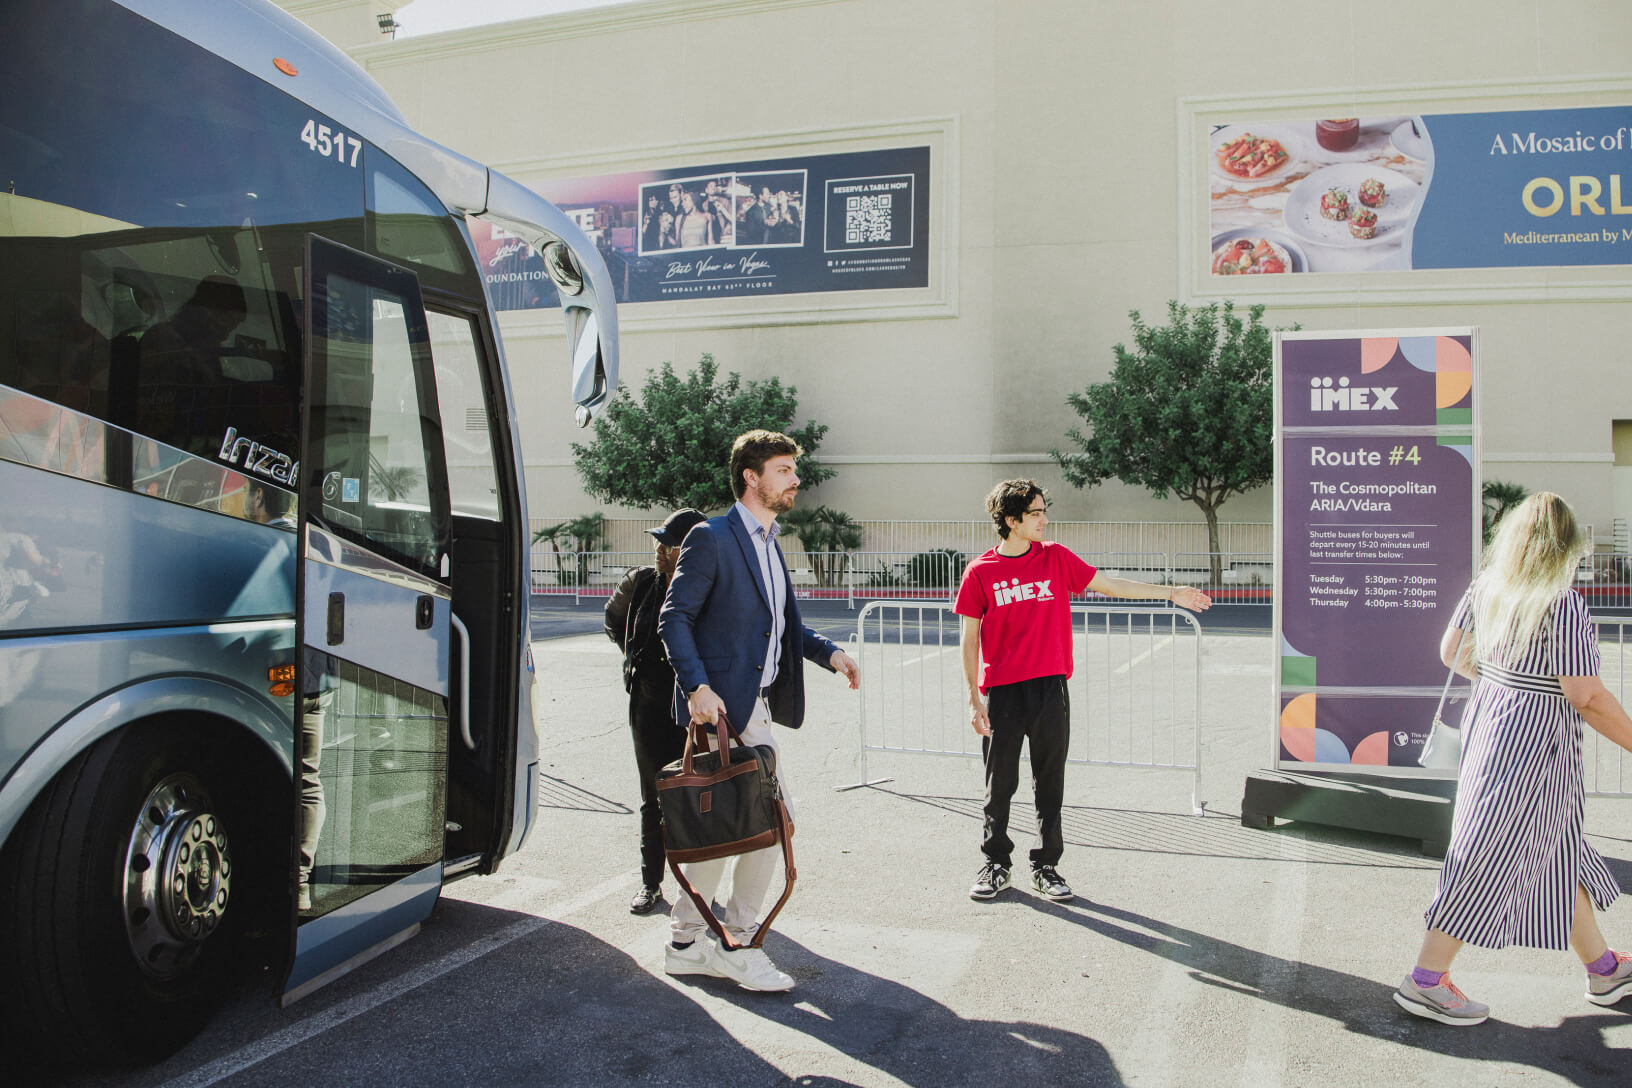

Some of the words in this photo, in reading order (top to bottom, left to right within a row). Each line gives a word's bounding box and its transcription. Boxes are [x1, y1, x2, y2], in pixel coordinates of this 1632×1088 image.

[301, 119, 362, 168] 4517
[1490, 133, 1508, 155] A
[1512, 130, 1596, 154] Mosaic
[1600, 127, 1627, 151] of
[833, 185, 863, 194] RESERVE
[863, 184, 869, 192] A
[869, 183, 890, 191] TABLE
[1521, 174, 1632, 217] ORL
[1504, 231, 1600, 244] Mediterranean
[1602, 228, 1619, 244] by
[665, 261, 693, 279] Best
[696, 255, 719, 277] View
[739, 251, 771, 275] Vegas
[486, 270, 549, 284] OUNDATION
[661, 286, 703, 294] MANDALAY
[707, 284, 722, 292] BAY
[746, 281, 773, 289] FLOOR
[1311, 446, 1381, 466] Route
[1388, 445, 1422, 466] #4
[1310, 481, 1337, 495] The
[1339, 480, 1437, 497] Cosmopolitan
[1310, 498, 1392, 512] ARIA/Vdara
[1310, 531, 1337, 539] Shuttle
[1338, 531, 1360, 539] buses
[1361, 531, 1372, 539] for
[1374, 531, 1400, 540] buyers
[1401, 531, 1415, 539] will
[1310, 541, 1335, 550] depart
[1335, 542, 1356, 550] every
[1380, 541, 1411, 549] minutes
[1412, 541, 1430, 549] until
[1310, 550, 1323, 558] last
[1325, 550, 1354, 558] transfer
[1310, 574, 1345, 584] Tuesday
[1364, 575, 1398, 586] 5:30pm
[1403, 576, 1437, 586] 7:00pm
[1310, 586, 1359, 597] Wednesday
[1364, 587, 1398, 597] 5:30pm
[1403, 587, 1437, 598] 7:00pm
[1310, 597, 1349, 608] Thursday
[1364, 599, 1399, 609] 4:00pm
[1403, 599, 1437, 610] 5:30pm
